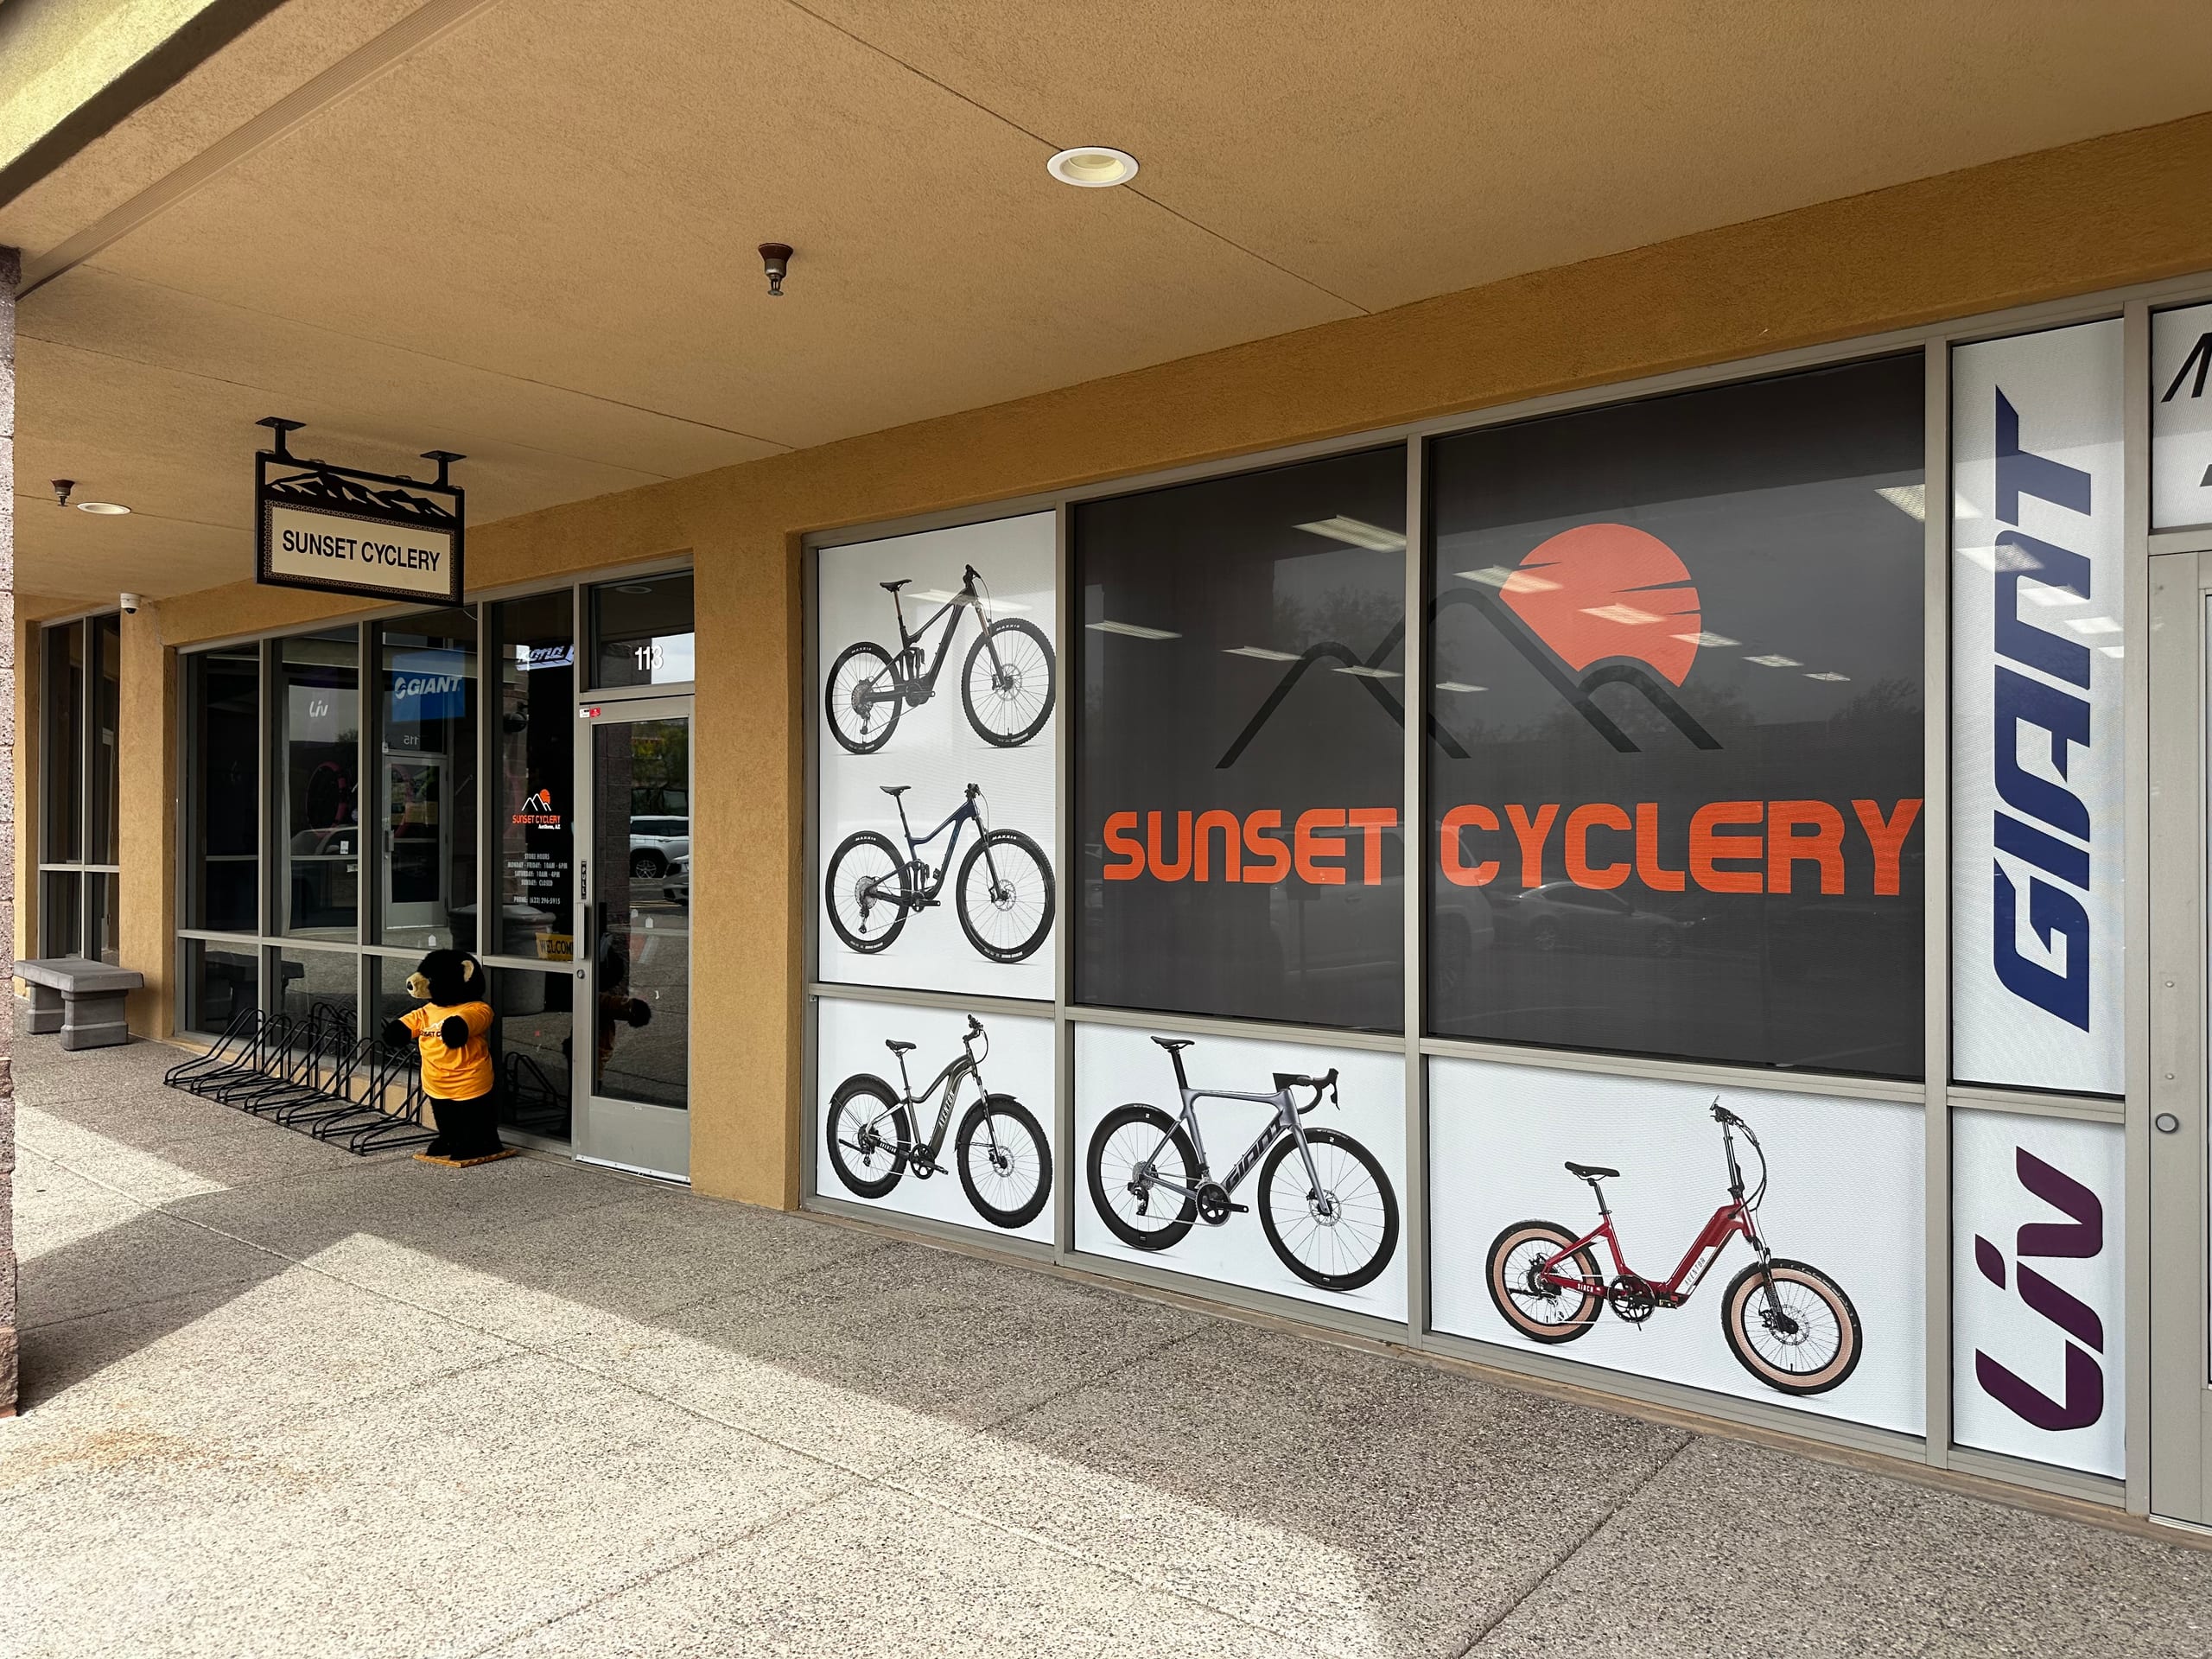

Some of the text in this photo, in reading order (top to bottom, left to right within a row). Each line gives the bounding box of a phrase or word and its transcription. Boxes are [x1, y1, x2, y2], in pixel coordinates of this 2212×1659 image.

[283, 530, 441, 572] SUNSET CYCLERY
[634, 645, 664, 671] 113
[407, 676, 462, 696] GIANT
[309, 700, 328, 718] Liv
[1993, 384, 2092, 1033] GIANT
[512, 815, 561, 824] SUNSET CYCLERY
[1103, 798, 1923, 896] SUNSET CYCLERY
[540, 939, 574, 955] WELCOM
[938, 1089, 955, 1129] AVENTON
[1684, 1256, 1706, 1287] AVENTON
[1974, 1145, 2104, 1432] Liv
